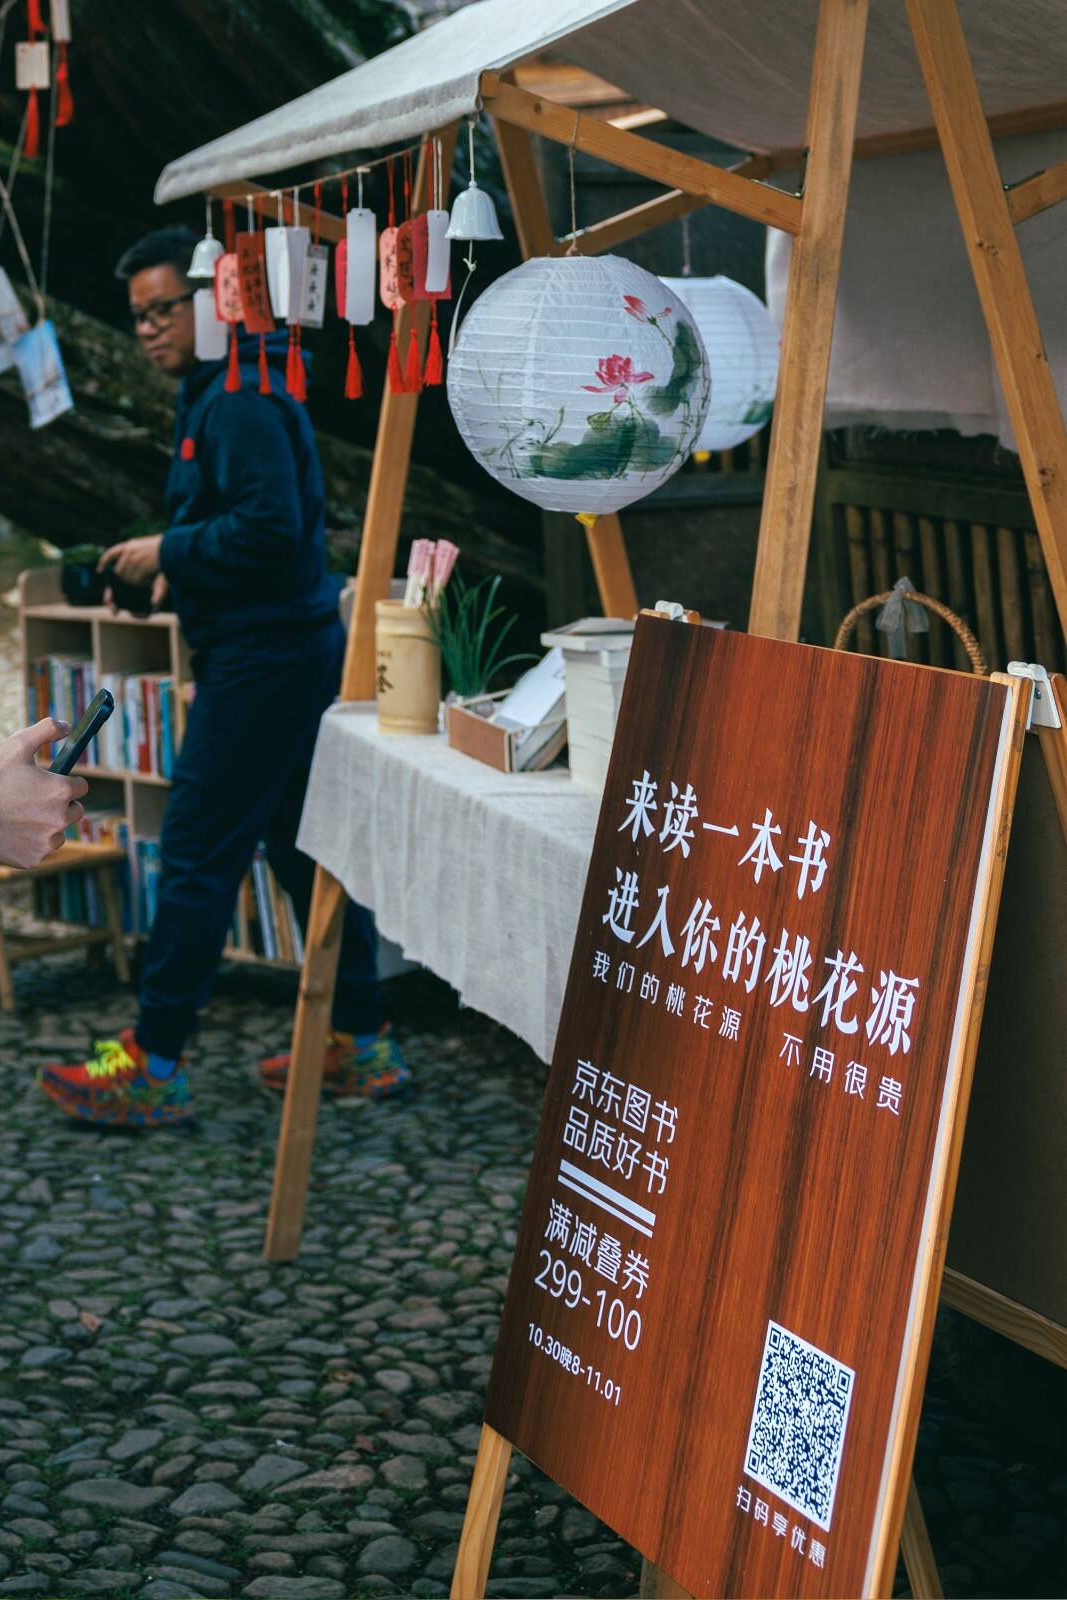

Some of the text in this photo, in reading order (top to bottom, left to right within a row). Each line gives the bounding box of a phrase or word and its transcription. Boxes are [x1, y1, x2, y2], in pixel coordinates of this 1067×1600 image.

[617, 769, 831, 901] 来读一本书
[602, 866, 920, 1057] 进入你的桃花源
[592, 950, 903, 1116] 我们的桃花源 不用很贵
[562, 1105, 670, 1195] 品质好书
[571, 1059, 679, 1144] 京东图书
[534, 1249, 642, 1351] 299-100
[544, 1198, 650, 1300] 满减叠券
[528, 1323, 621, 1406] 10.30晚8-11.01
[736, 1484, 827, 1569] 扫码享优惠
